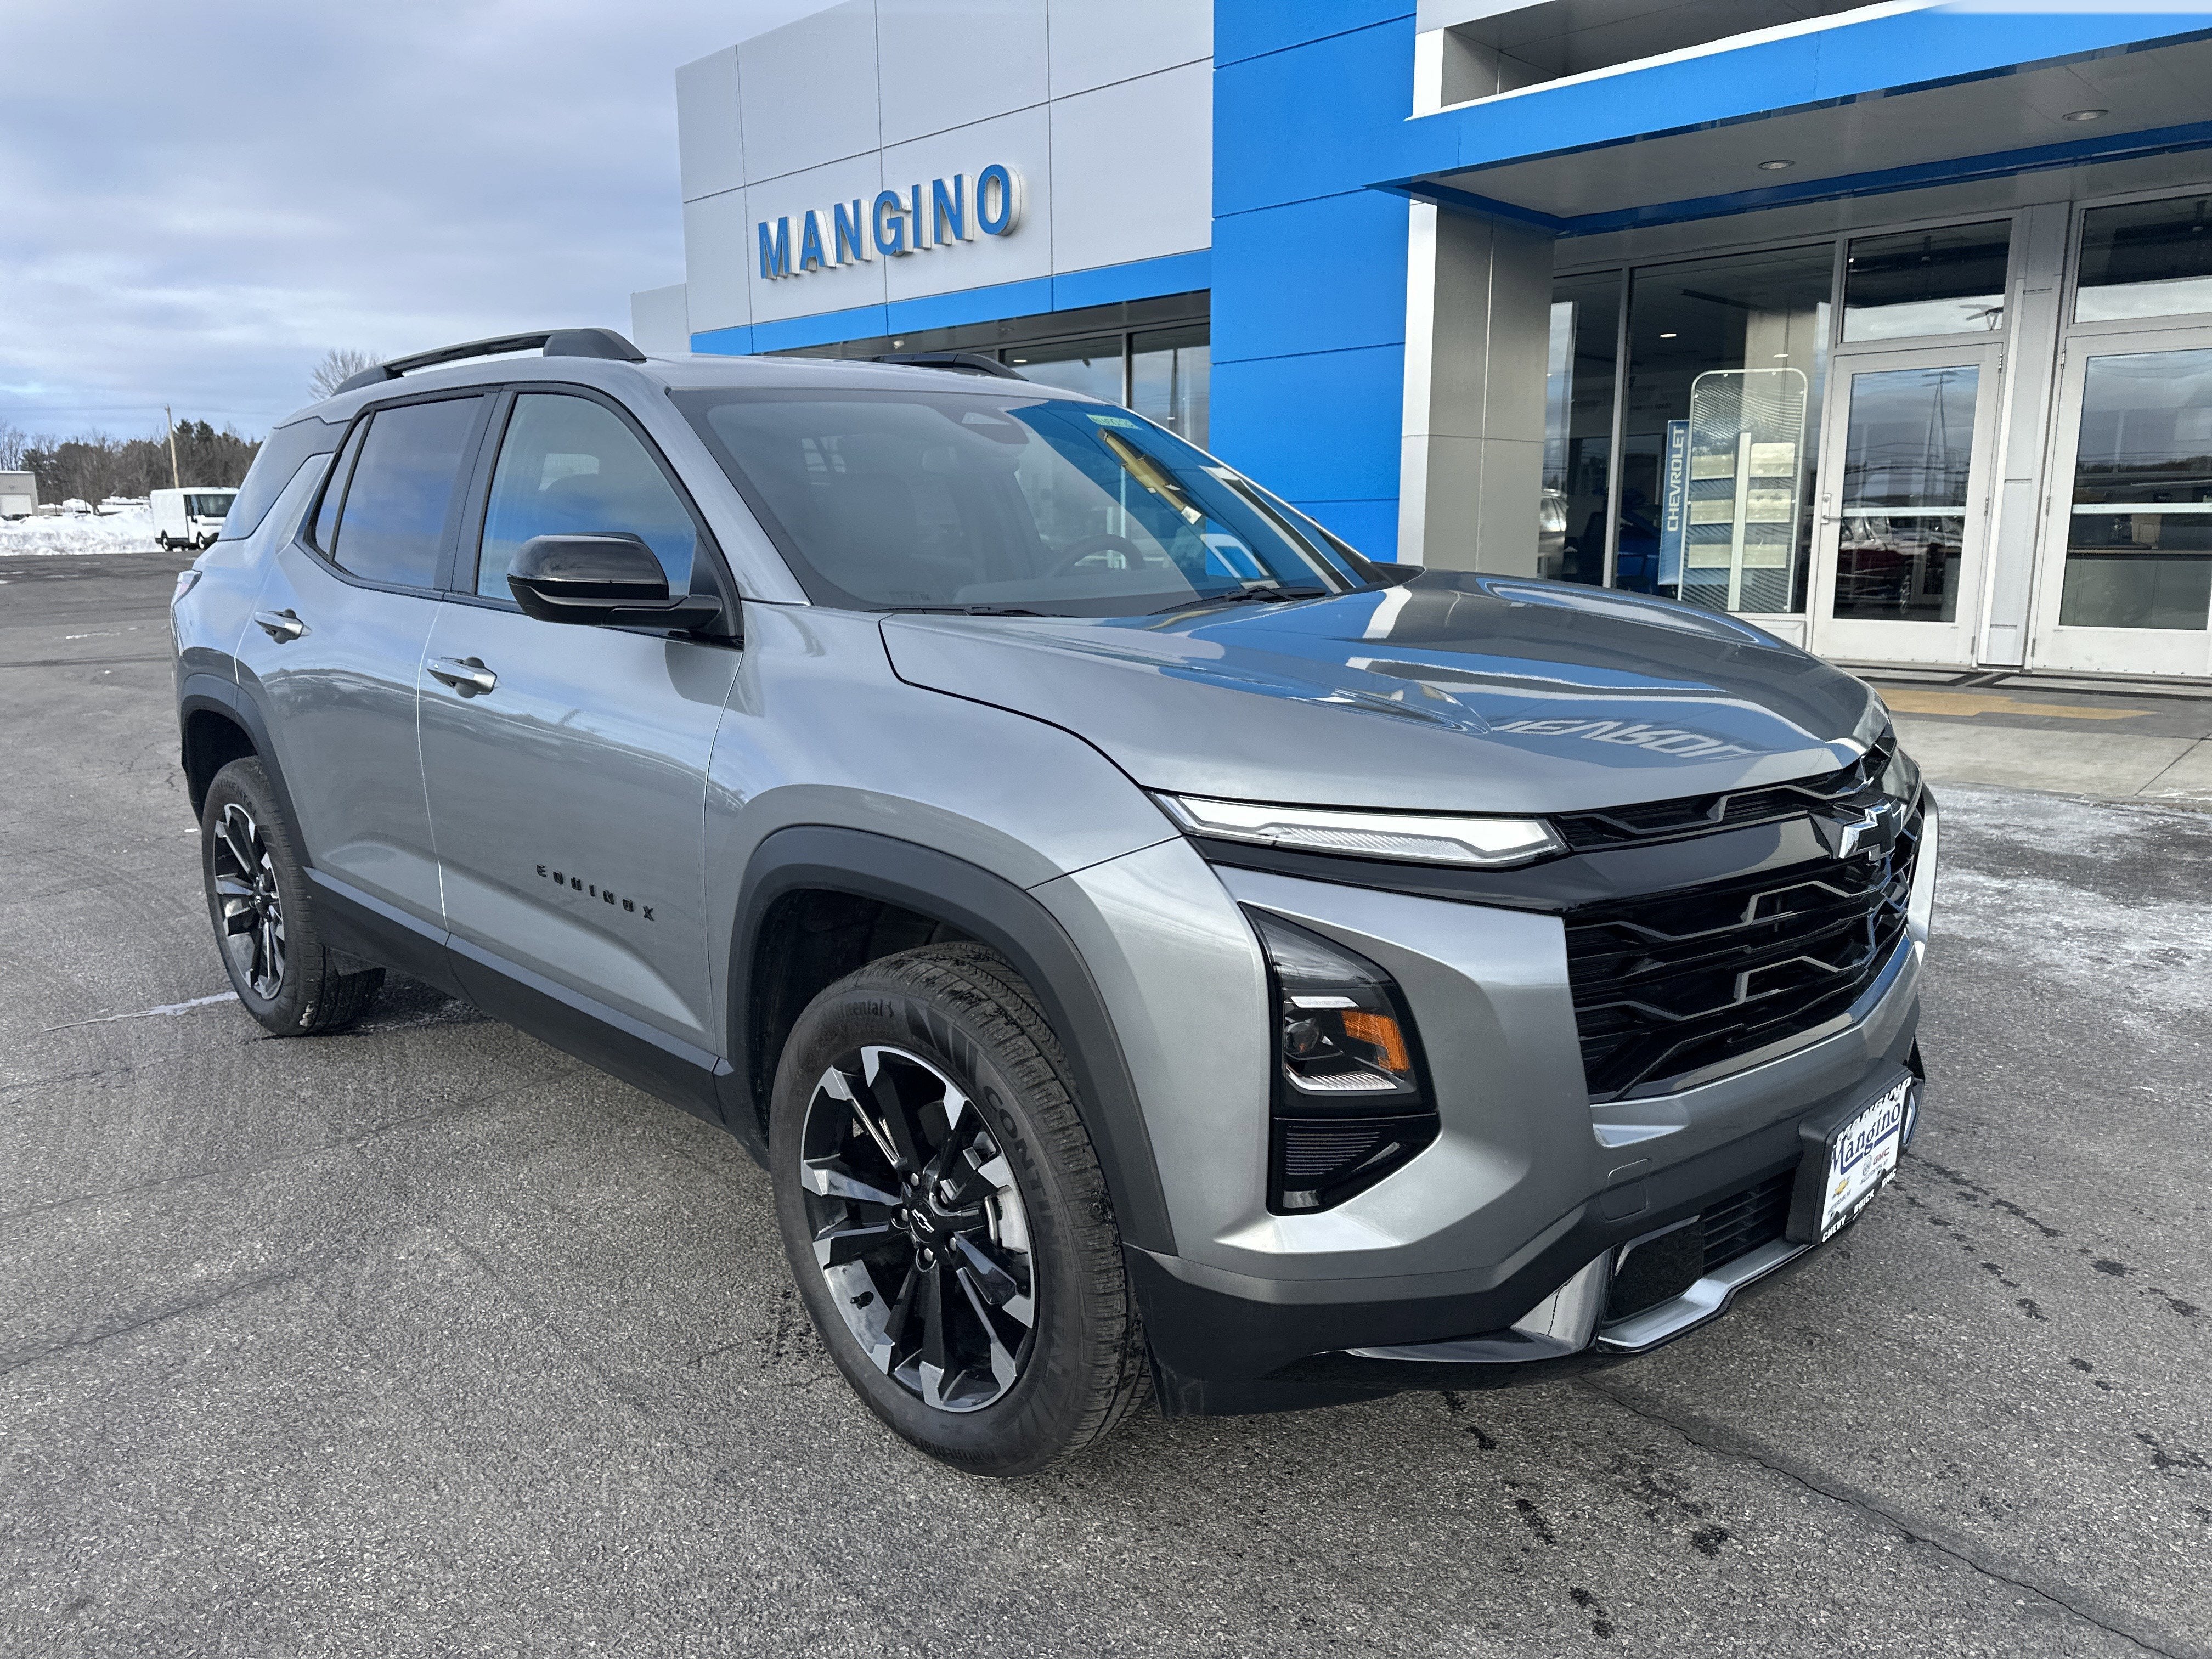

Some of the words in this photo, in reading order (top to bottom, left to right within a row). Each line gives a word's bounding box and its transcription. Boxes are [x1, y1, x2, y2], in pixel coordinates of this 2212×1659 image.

[758, 163, 1019, 280] MANGINO
[1667, 426, 1685, 531] CHEVROLET
[536, 864, 654, 921] EQUINOX
[1832, 1102, 1901, 1175] Mangino
[1872, 1147, 1890, 1166] GMC
[1822, 1215, 1847, 1243] CHEVY
[1854, 1188, 1875, 1214] BUICK
[1881, 1168, 1897, 1188] GMC
